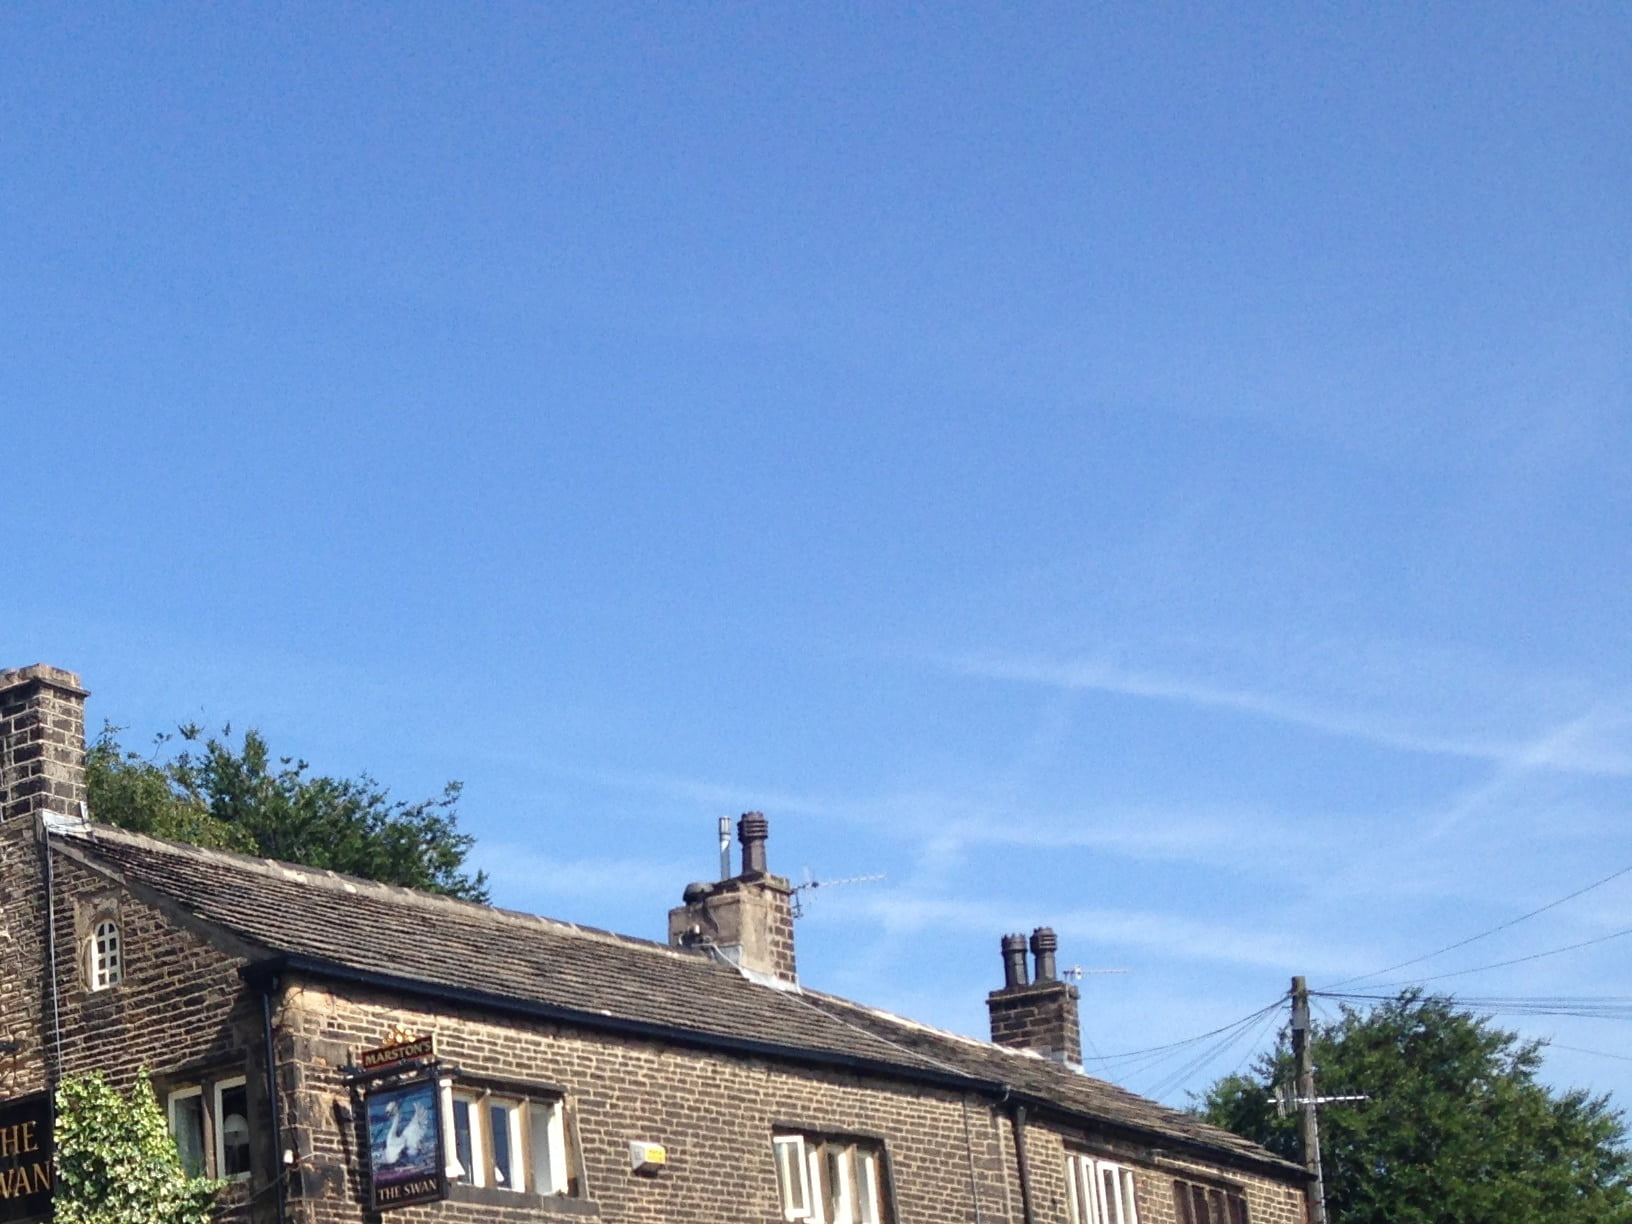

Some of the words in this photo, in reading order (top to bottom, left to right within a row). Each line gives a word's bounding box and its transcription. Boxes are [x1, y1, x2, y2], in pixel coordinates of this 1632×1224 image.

[366, 1042, 432, 1066] MARSTON'S
[377, 1186, 402, 1201] THE
[404, 1178, 437, 1197] SWAN
